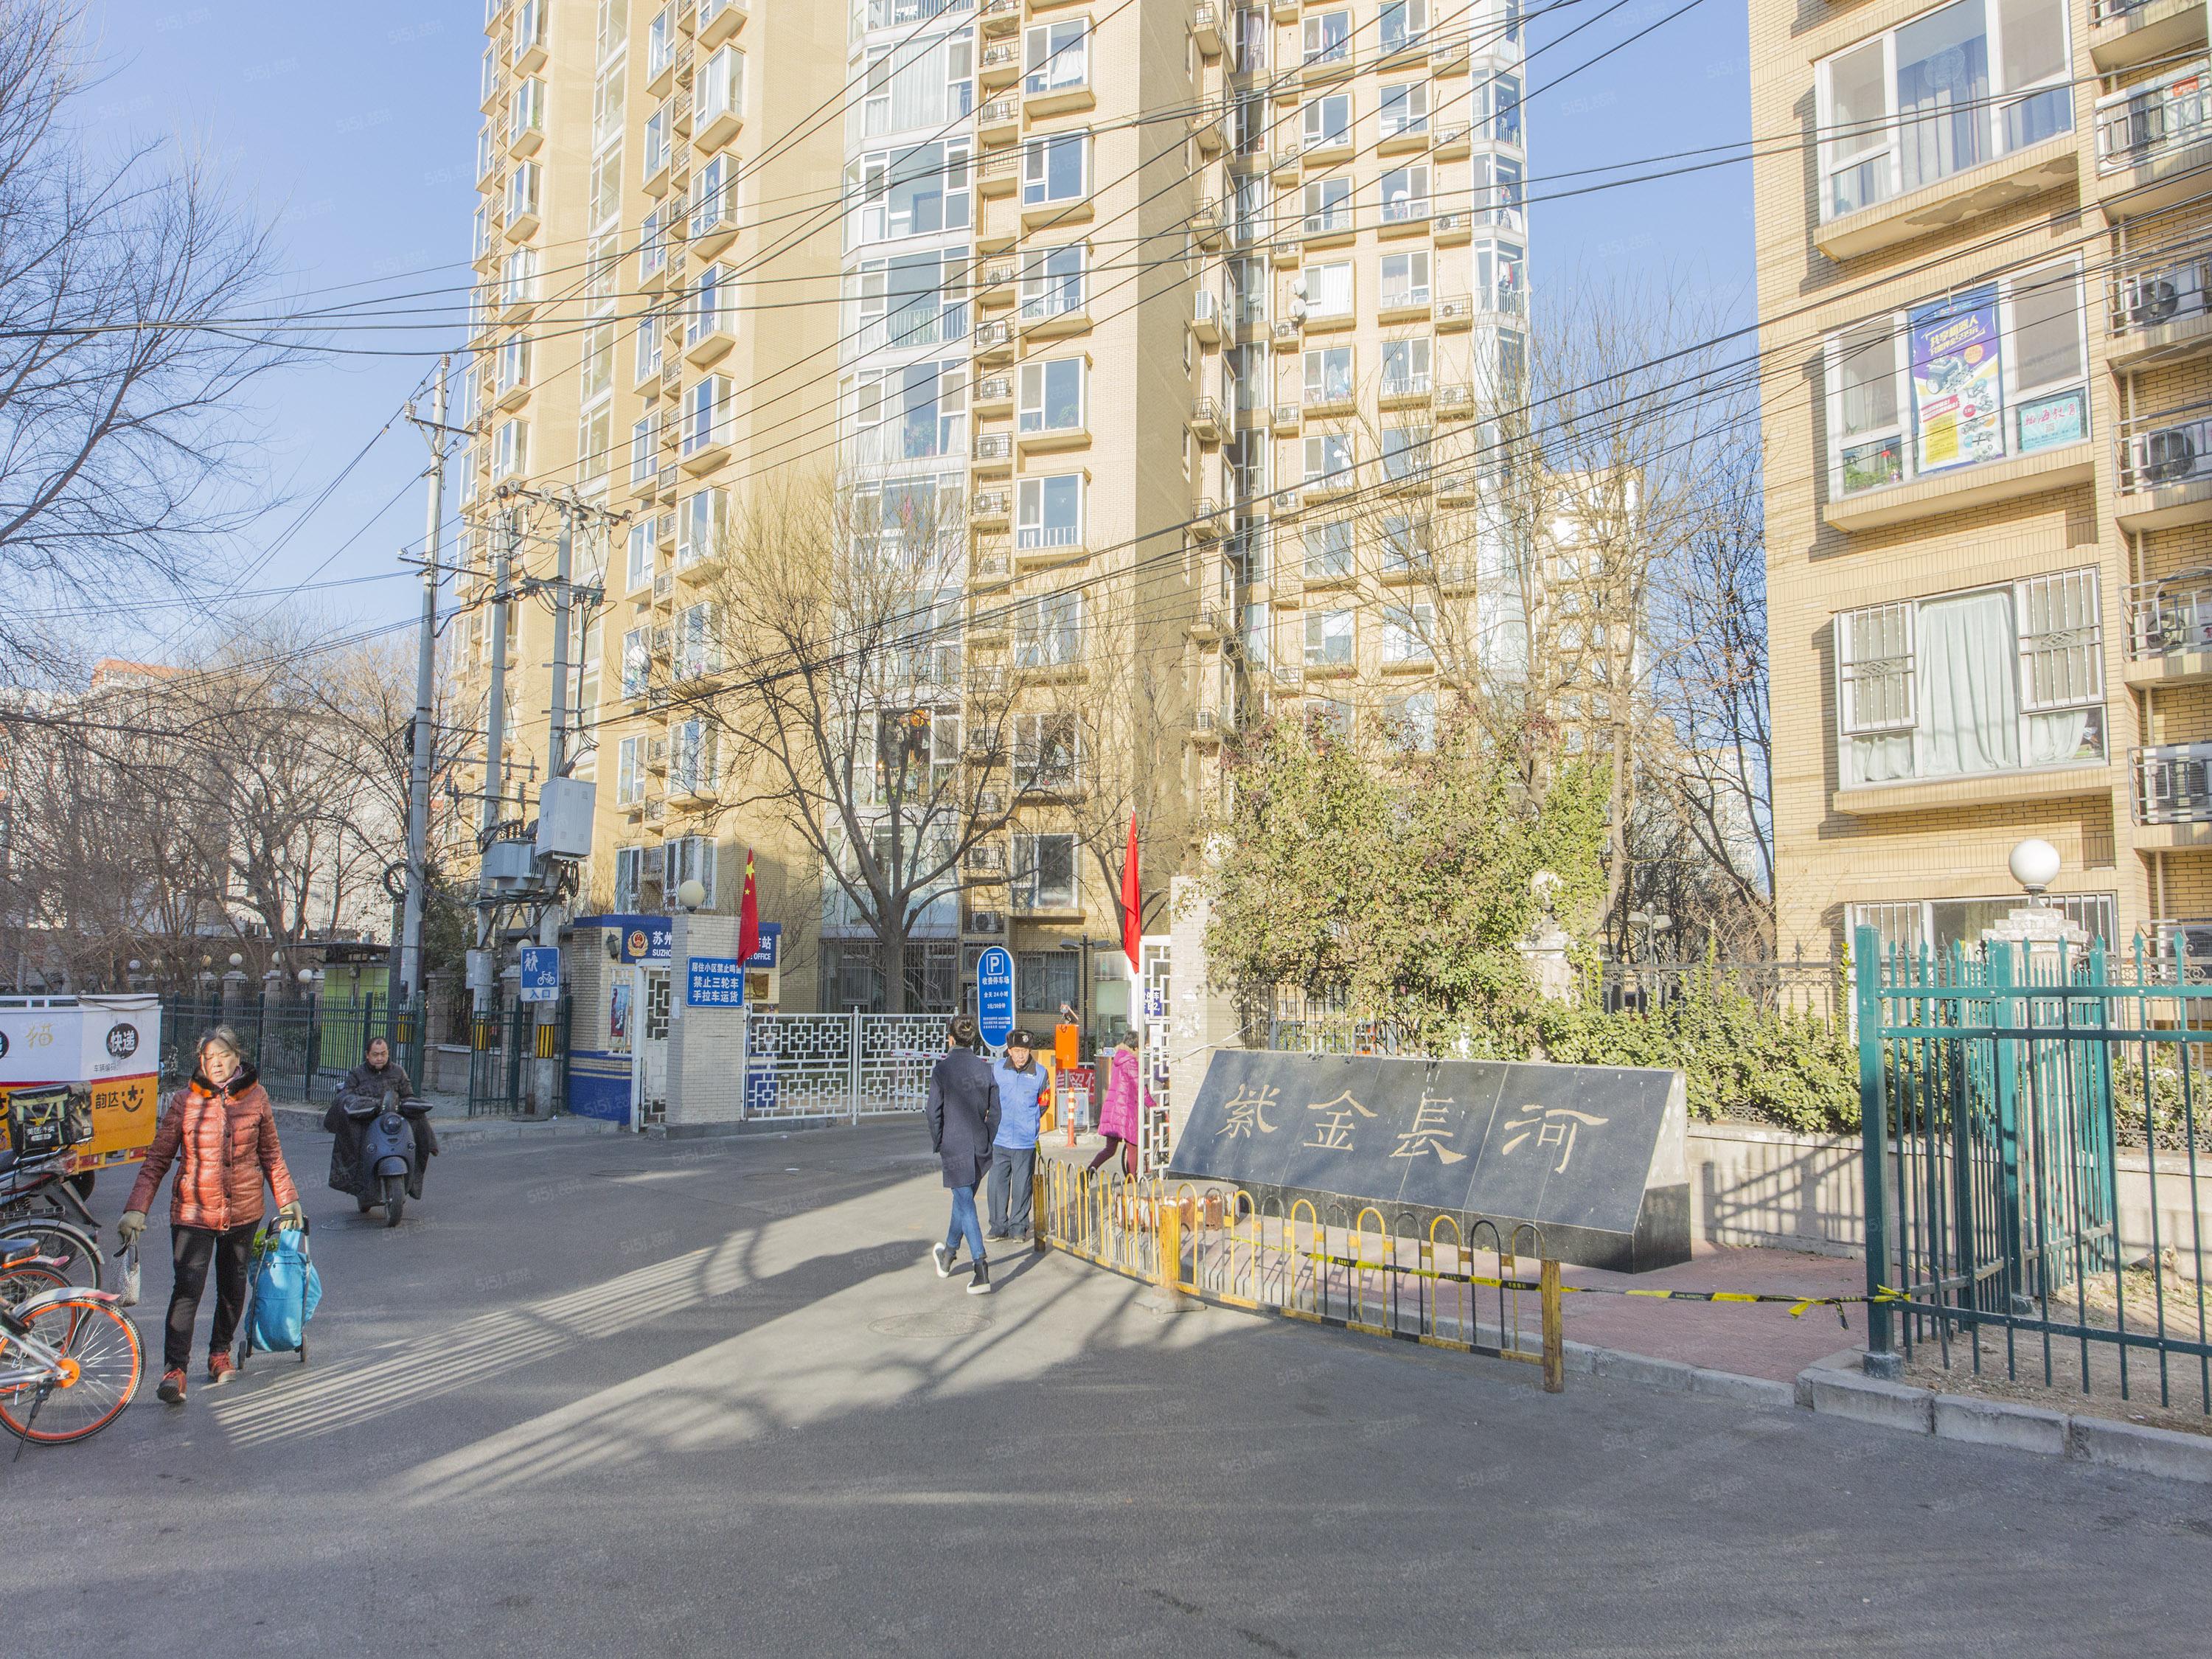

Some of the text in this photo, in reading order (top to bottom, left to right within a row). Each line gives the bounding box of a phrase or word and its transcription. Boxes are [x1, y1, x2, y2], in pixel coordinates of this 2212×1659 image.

[753, 953, 771, 961] OFFICE
[692, 962, 742, 974] 居住小区禁止鸣笛
[990, 956, 1000, 972] P
[693, 975, 739, 989] 禁止三轮车
[982, 976, 1009, 985] 收费停车场
[530, 990, 551, 999] 入口
[692, 990, 739, 1003] 手拉车运货
[110, 1030, 136, 1054] 快递
[95, 1091, 119, 1110] 韵达
[27, 1126, 55, 1136] 美团外卖
